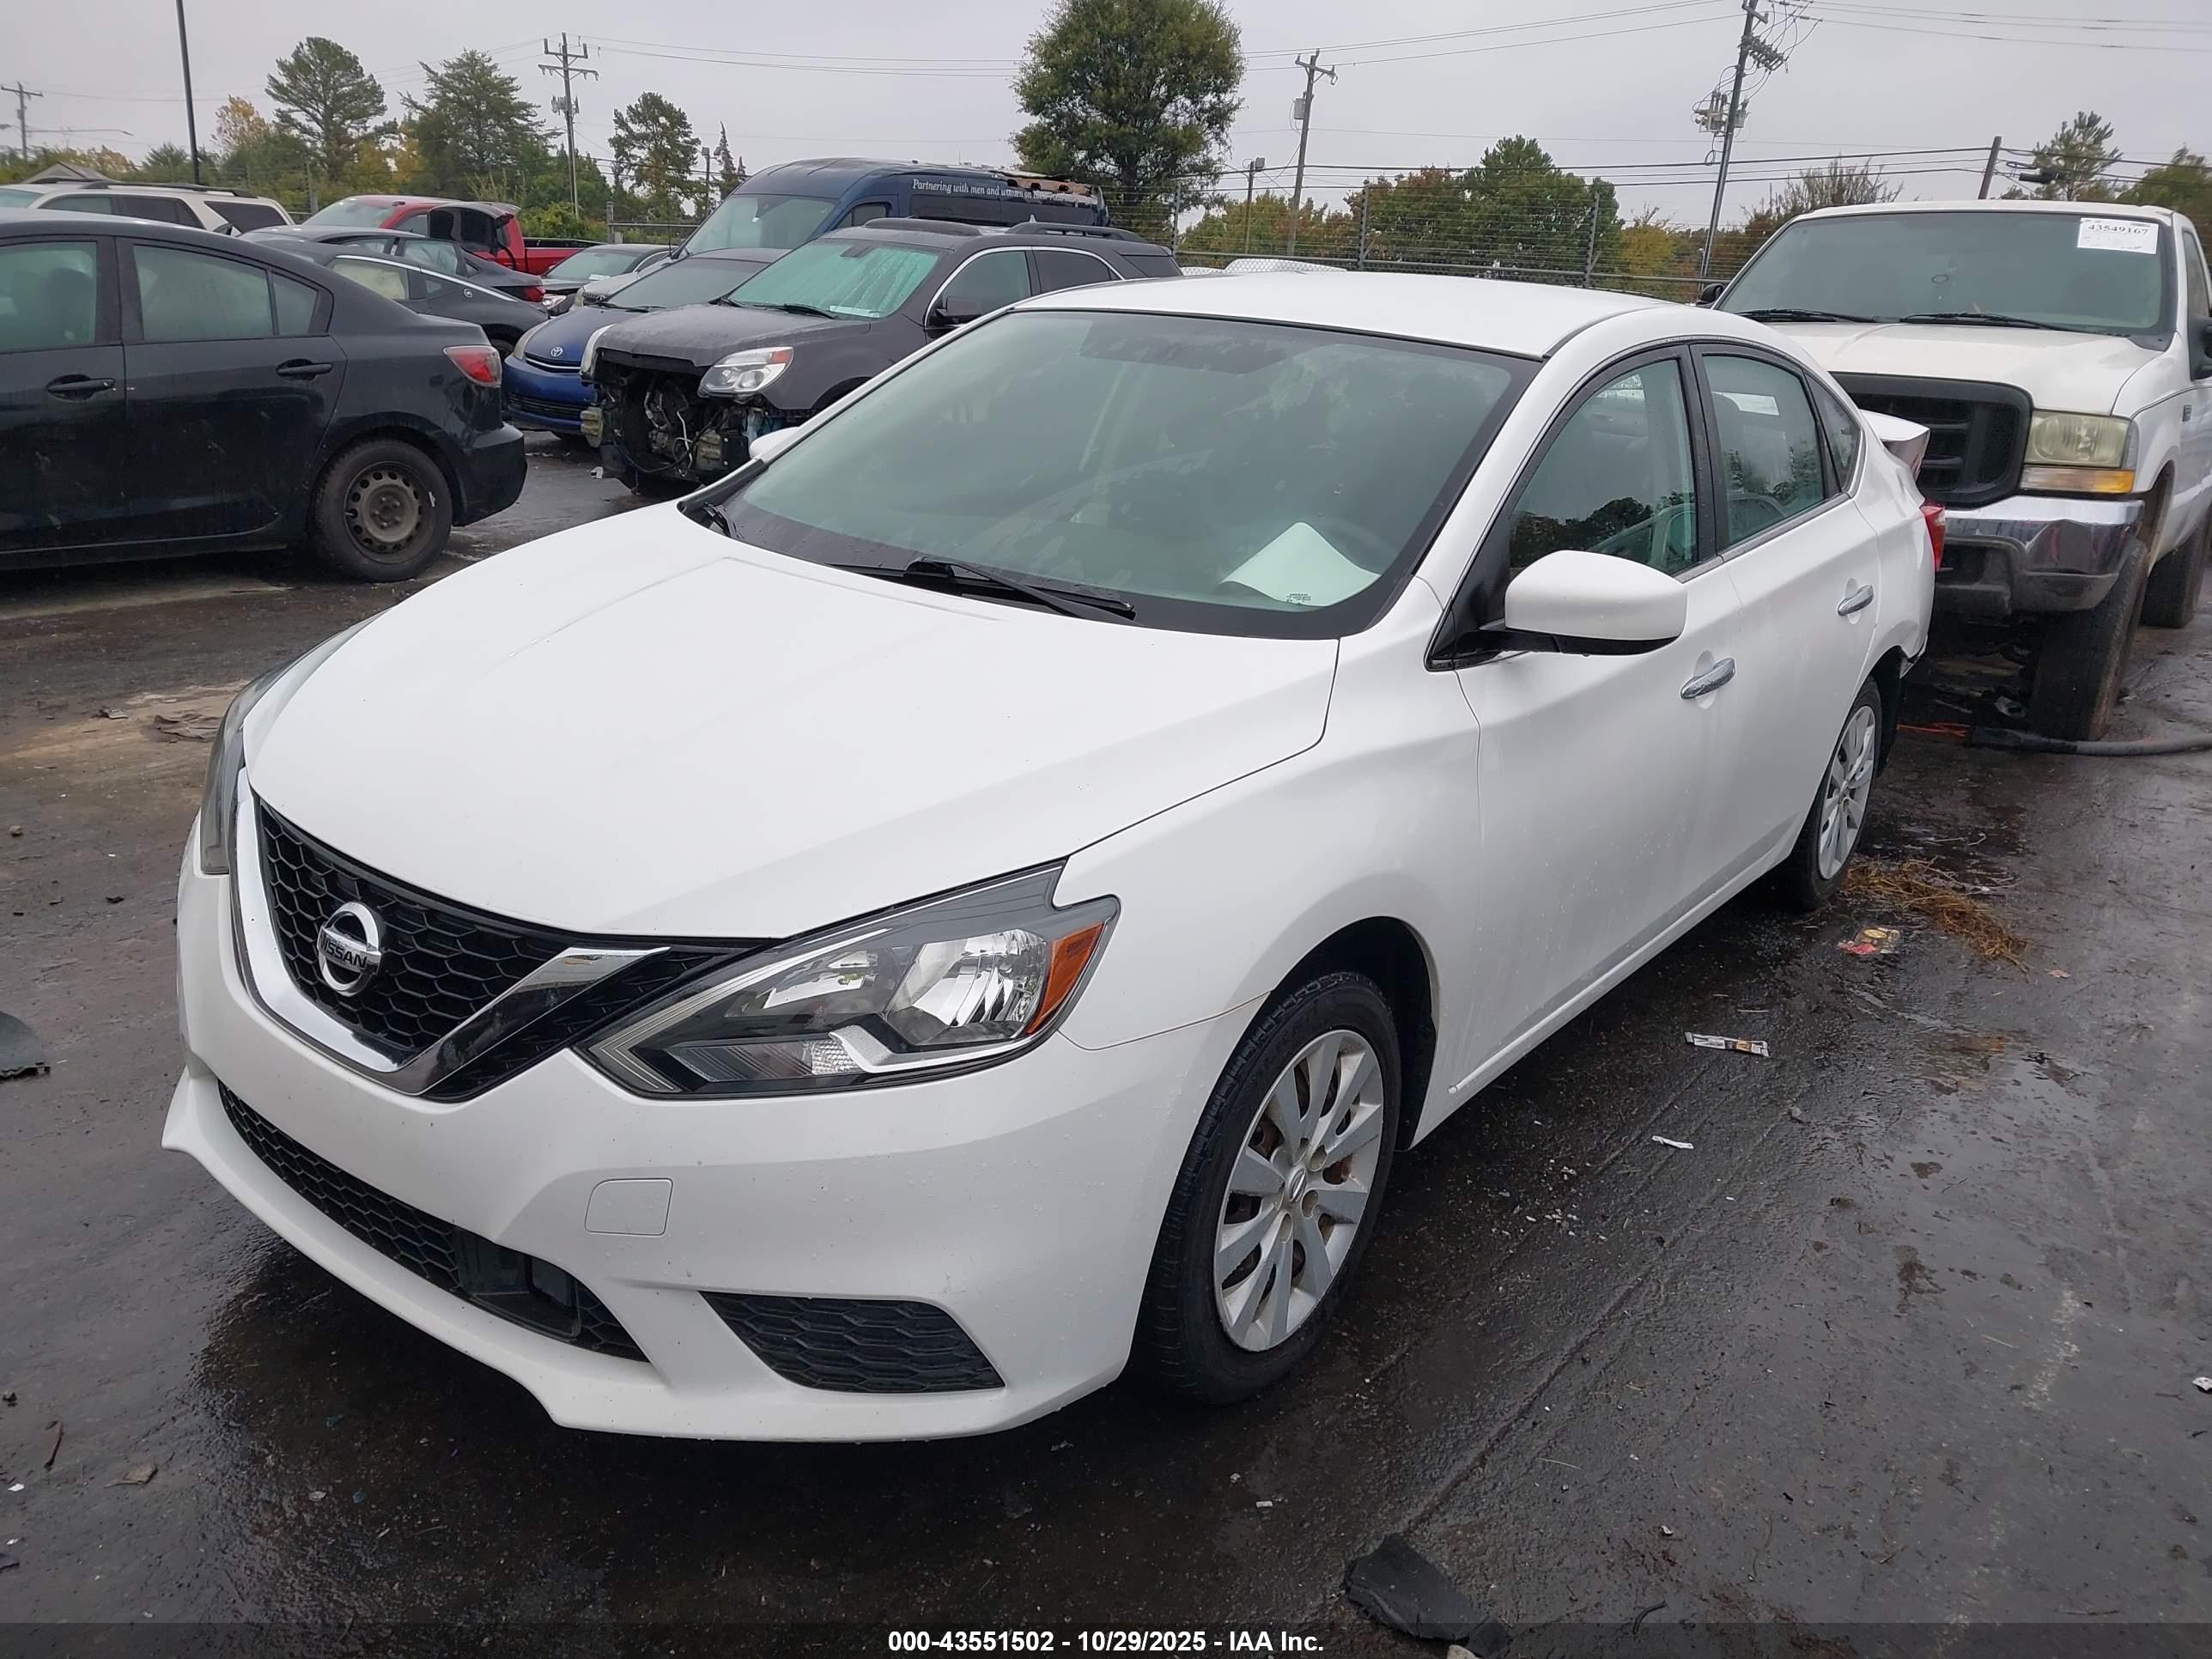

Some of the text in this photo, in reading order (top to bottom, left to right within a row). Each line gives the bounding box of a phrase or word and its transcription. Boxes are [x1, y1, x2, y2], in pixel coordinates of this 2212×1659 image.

[913, 178, 951, 194] Partnering
[953, 182, 969, 193] with
[970, 185, 985, 194] men
[987, 185, 1000, 196] and
[1000, 188, 1024, 198] women
[1024, 191, 1032, 199] on
[2087, 224, 2150, 235] 43549167
[319, 932, 368, 969] NISSAN
